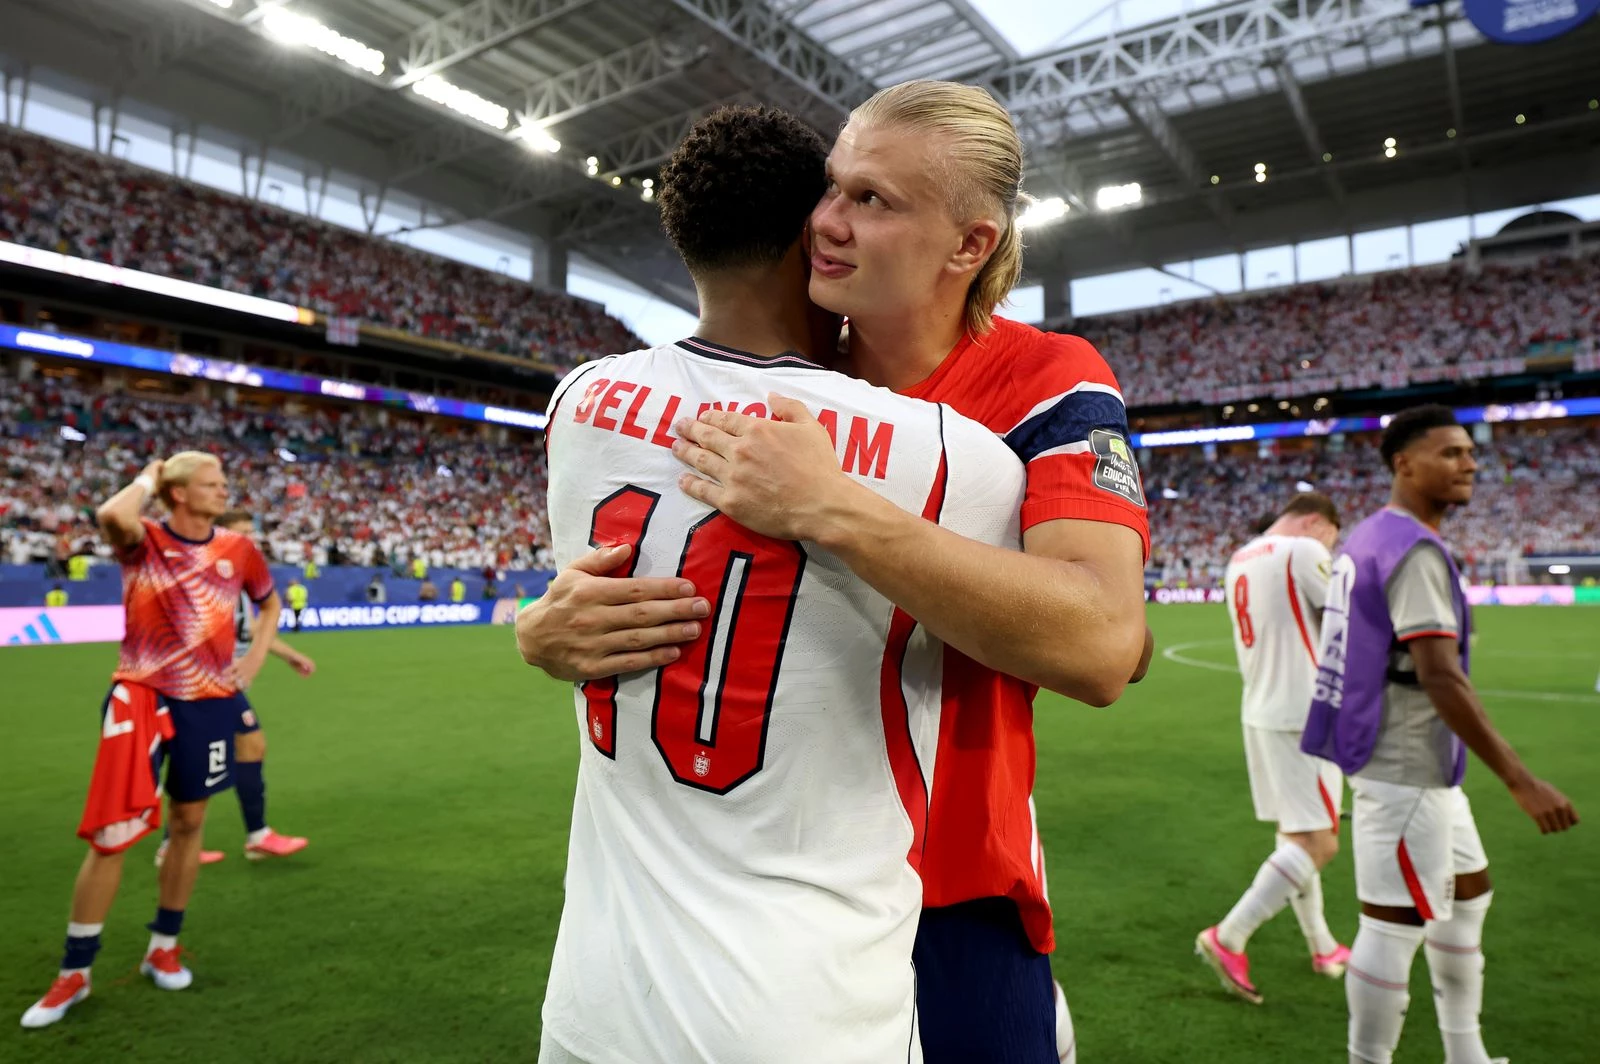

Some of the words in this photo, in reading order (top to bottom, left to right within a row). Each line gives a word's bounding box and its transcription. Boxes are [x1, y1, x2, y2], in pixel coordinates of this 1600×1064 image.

[573, 378, 894, 479] BELLAM
[319, 606, 385, 626] WORLD
[386, 605, 420, 624] CUP
[420, 603, 479, 622] 2026
[581, 484, 808, 795] 10
[1234, 574, 1255, 648] 8
[208, 740, 226, 773] 2
